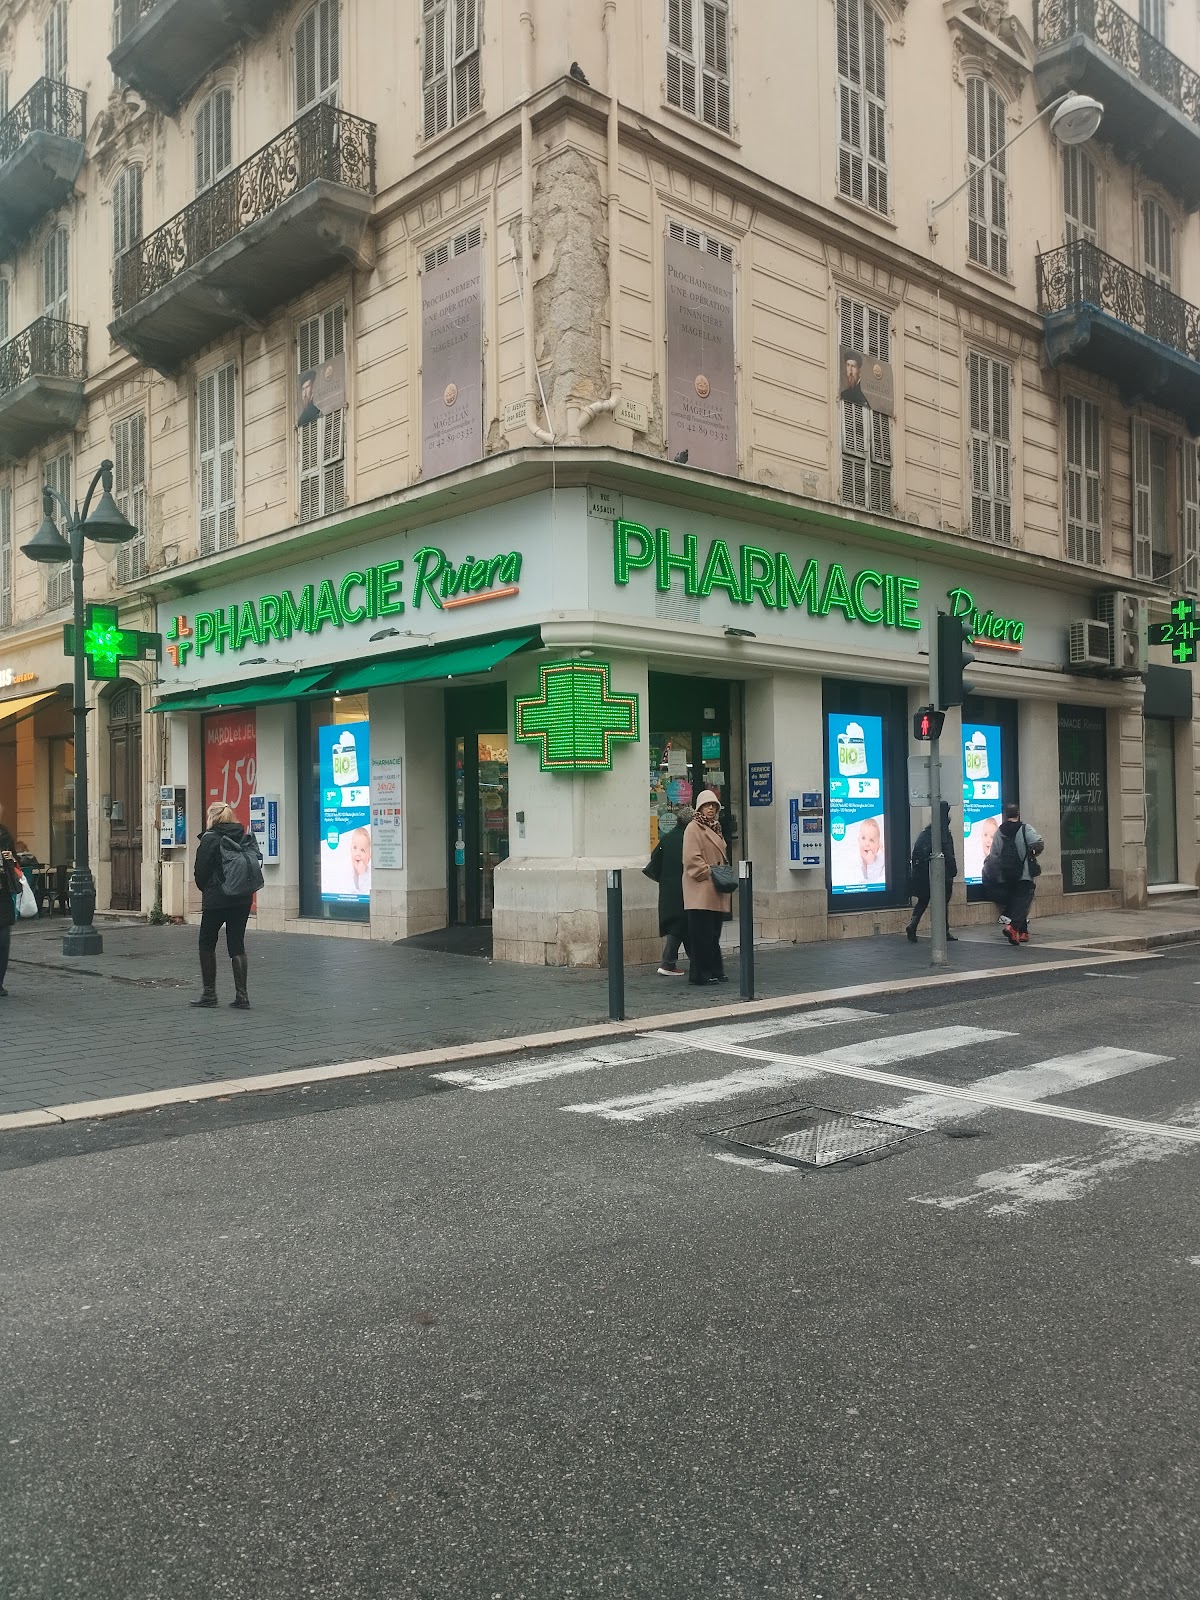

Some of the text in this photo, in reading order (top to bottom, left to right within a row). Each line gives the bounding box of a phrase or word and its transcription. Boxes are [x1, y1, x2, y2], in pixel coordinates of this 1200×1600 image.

[667, 264, 733, 300] PROCHAINEMENT
[670, 284, 687, 297] UNE
[422, 275, 481, 311] PROCHAINEMENT
[424, 312, 438, 326] UNE
[432, 331, 469, 353] MAGELLAN
[681, 323, 722, 344] MAGELLAN
[626, 402, 636, 412] RUE
[682, 403, 723, 421] MAGELLAN
[432, 410, 469, 431] MAGELLAN
[620, 410, 641, 422] ASSALIT
[687, 424, 696, 433] 42
[698, 426, 708, 437] 89
[710, 429, 718, 440] 03
[719, 432, 728, 441] 32
[600, 493, 610, 502] RUE
[592, 503, 616, 515] ASSALIT
[613, 520, 1026, 645] PHARMACIE Riviera
[196, 546, 522, 657] PHARMACIE Riviera
[234, 725, 242, 741] et
[371, 758, 401, 767] PHARMACIE
[839, 747, 858, 765] BIO
[966, 753, 981, 769] BIO
[334, 757, 350, 775] BIO
